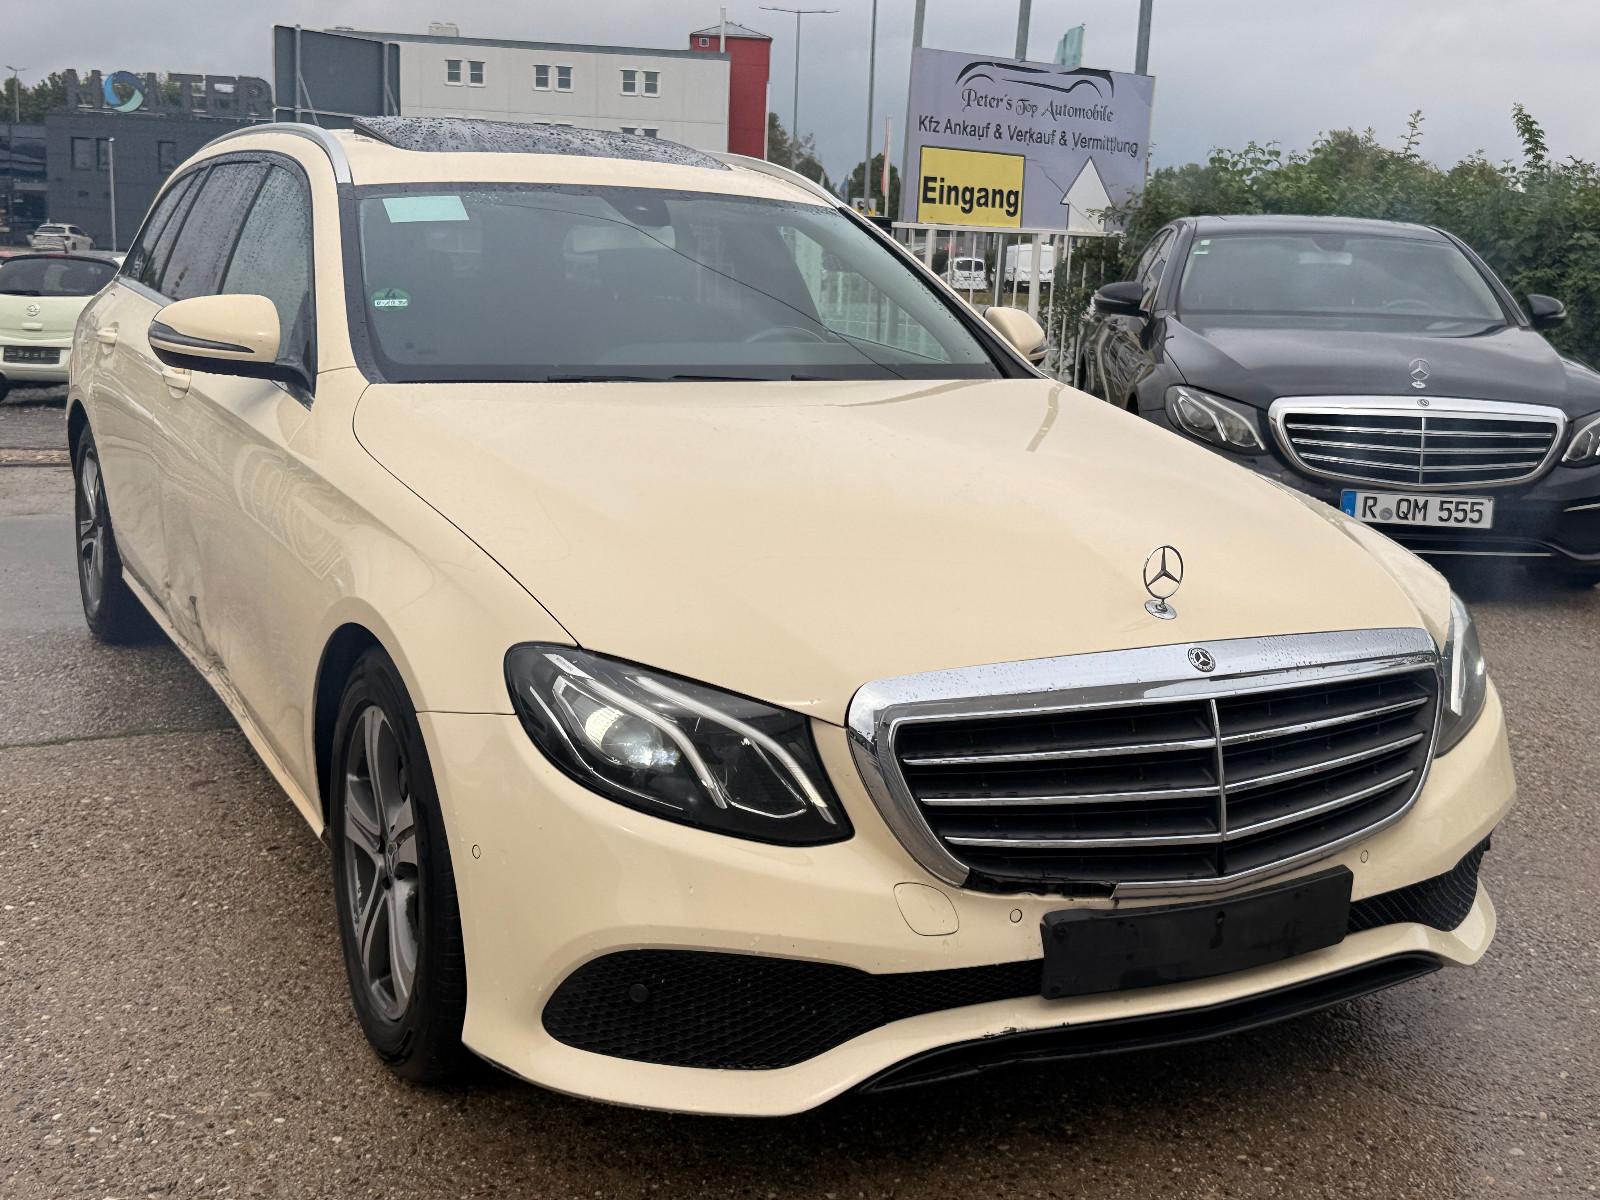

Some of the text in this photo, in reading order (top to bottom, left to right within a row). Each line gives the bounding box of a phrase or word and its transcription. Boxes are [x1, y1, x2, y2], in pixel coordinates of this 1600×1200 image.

[1015, 97, 1038, 118] Top
[1041, 100, 1114, 122] Automobile
[918, 115, 1139, 158] Kfz Ankauf & Verkauf & Vermittlung
[922, 176, 1020, 218] Eingang
[1361, 496, 1484, 524] R QM 555
